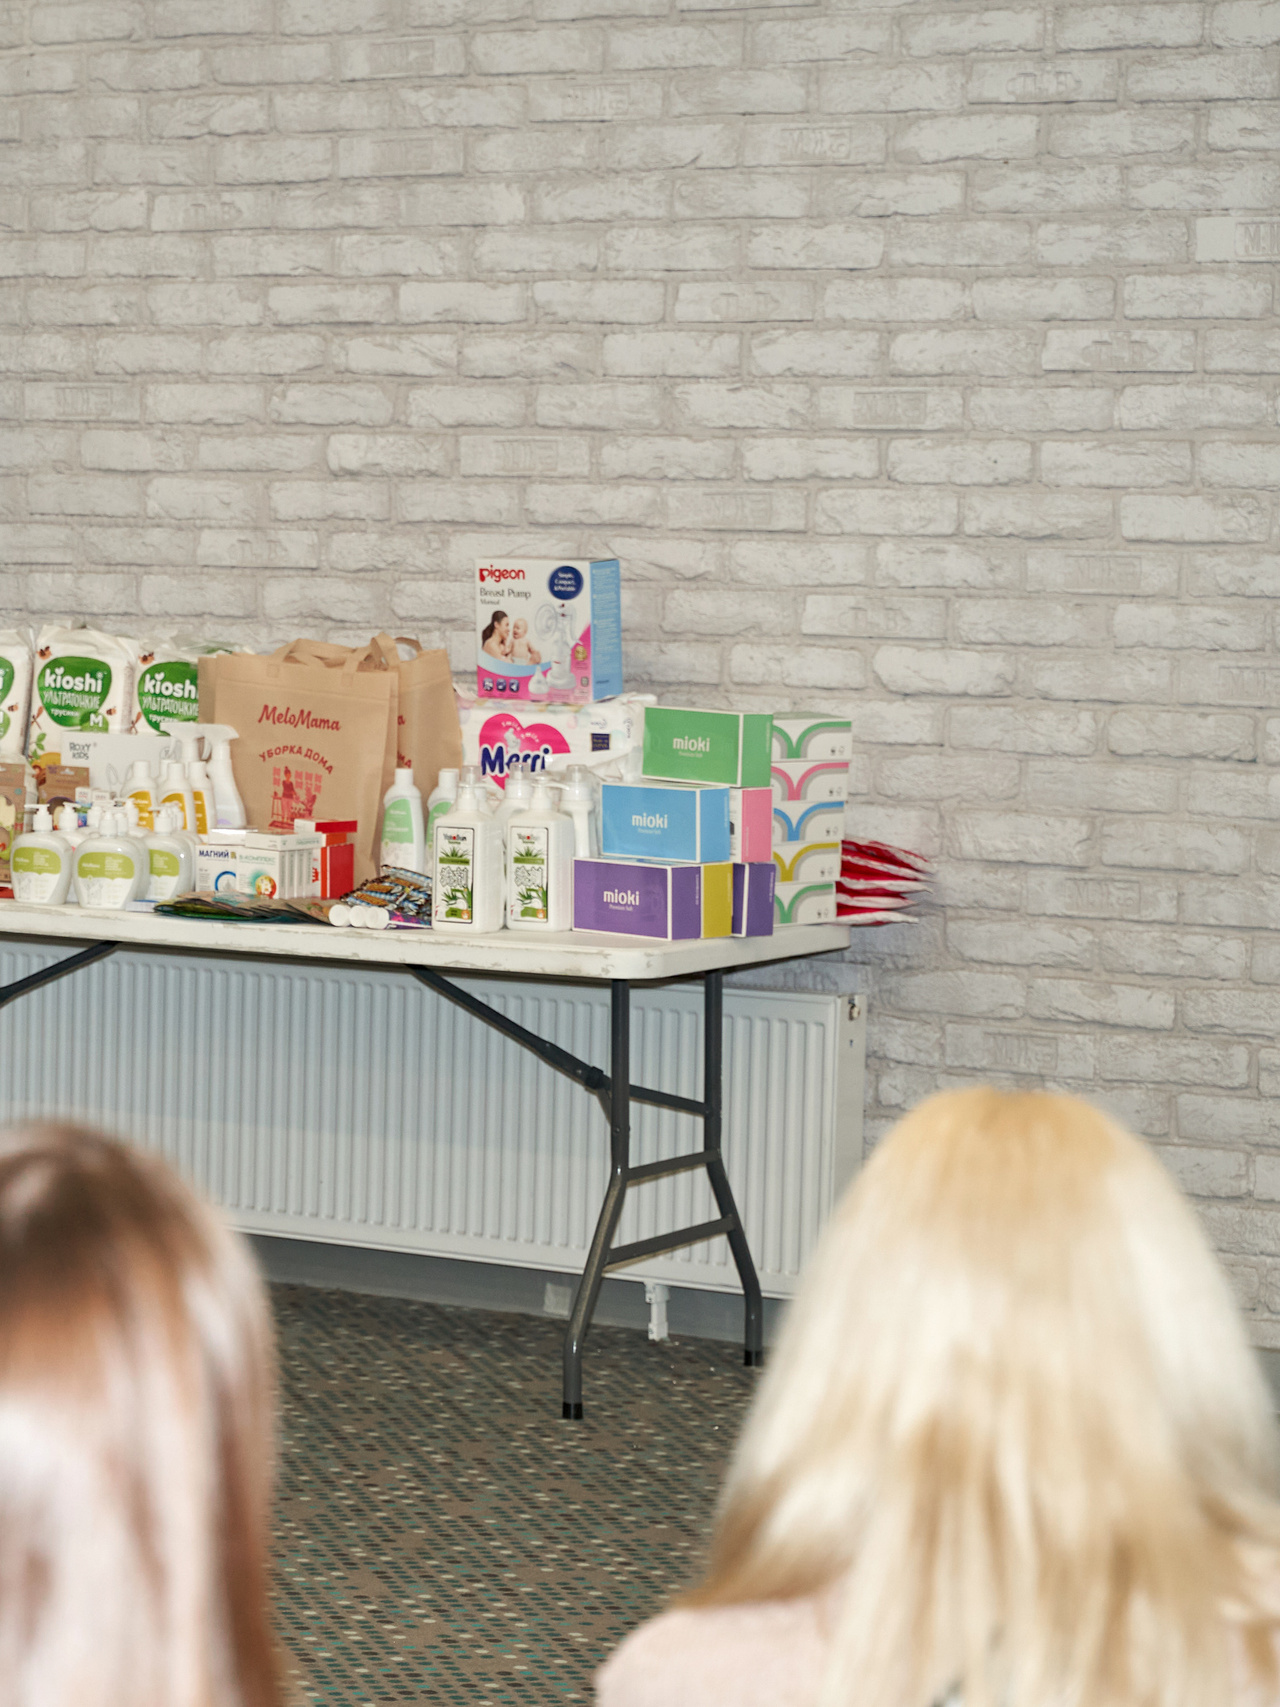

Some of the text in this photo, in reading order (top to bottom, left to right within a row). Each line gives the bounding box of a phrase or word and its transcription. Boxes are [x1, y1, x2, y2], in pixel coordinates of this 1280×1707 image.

[479, 565, 525, 582] pigeon
[480, 587, 531, 600] Breast Pump
[45, 667, 103, 693] kioshi
[144, 671, 198, 699] kiosh
[43, 691, 101, 709] УЛЬТРАТОНКИЕ
[89, 713, 103, 728] M
[258, 704, 341, 731] MeloMama
[69, 741, 92, 752] ROXY
[672, 735, 711, 753] mioki
[258, 745, 334, 774] УБОРКА ДОМА
[631, 812, 668, 829] mioki
[199, 849, 229, 859] МАГНИЙ
[603, 889, 640, 906] mioki
